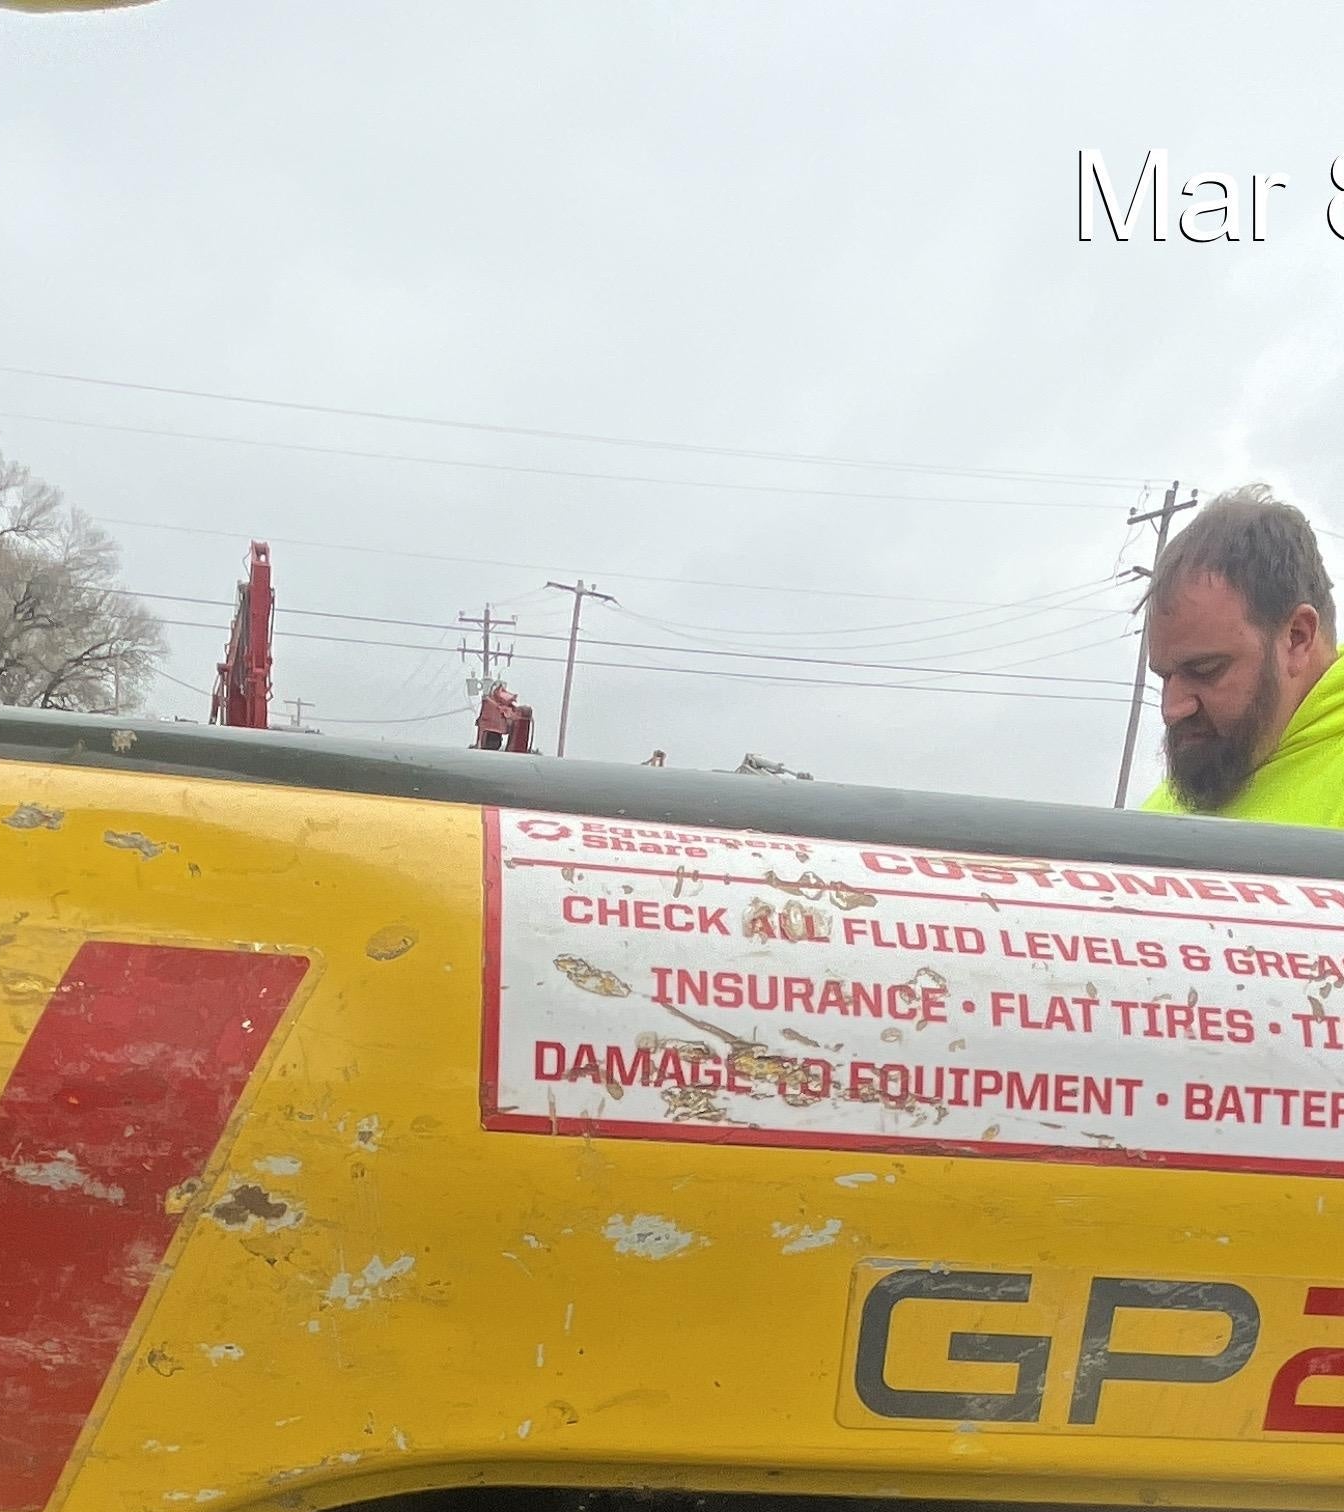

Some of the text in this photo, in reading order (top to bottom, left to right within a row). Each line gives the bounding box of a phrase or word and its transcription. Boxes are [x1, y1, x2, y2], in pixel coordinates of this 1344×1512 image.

[581, 821, 814, 853] Equipment
[582, 834, 709, 859] Share
[859, 850, 1291, 907] CUSTOMER
[561, 895, 731, 937] CHECK
[842, 917, 987, 955] FLUID
[999, 929, 1168, 969] LEVELS
[1178, 943, 1211, 973] &
[650, 966, 948, 1023] INSURANCE
[990, 991, 1101, 1034] FLAT
[1111, 999, 1255, 1044] TIRES
[534, 1039, 754, 1095] DAMAGE
[849, 1060, 1145, 1118] EQUIPMENT
